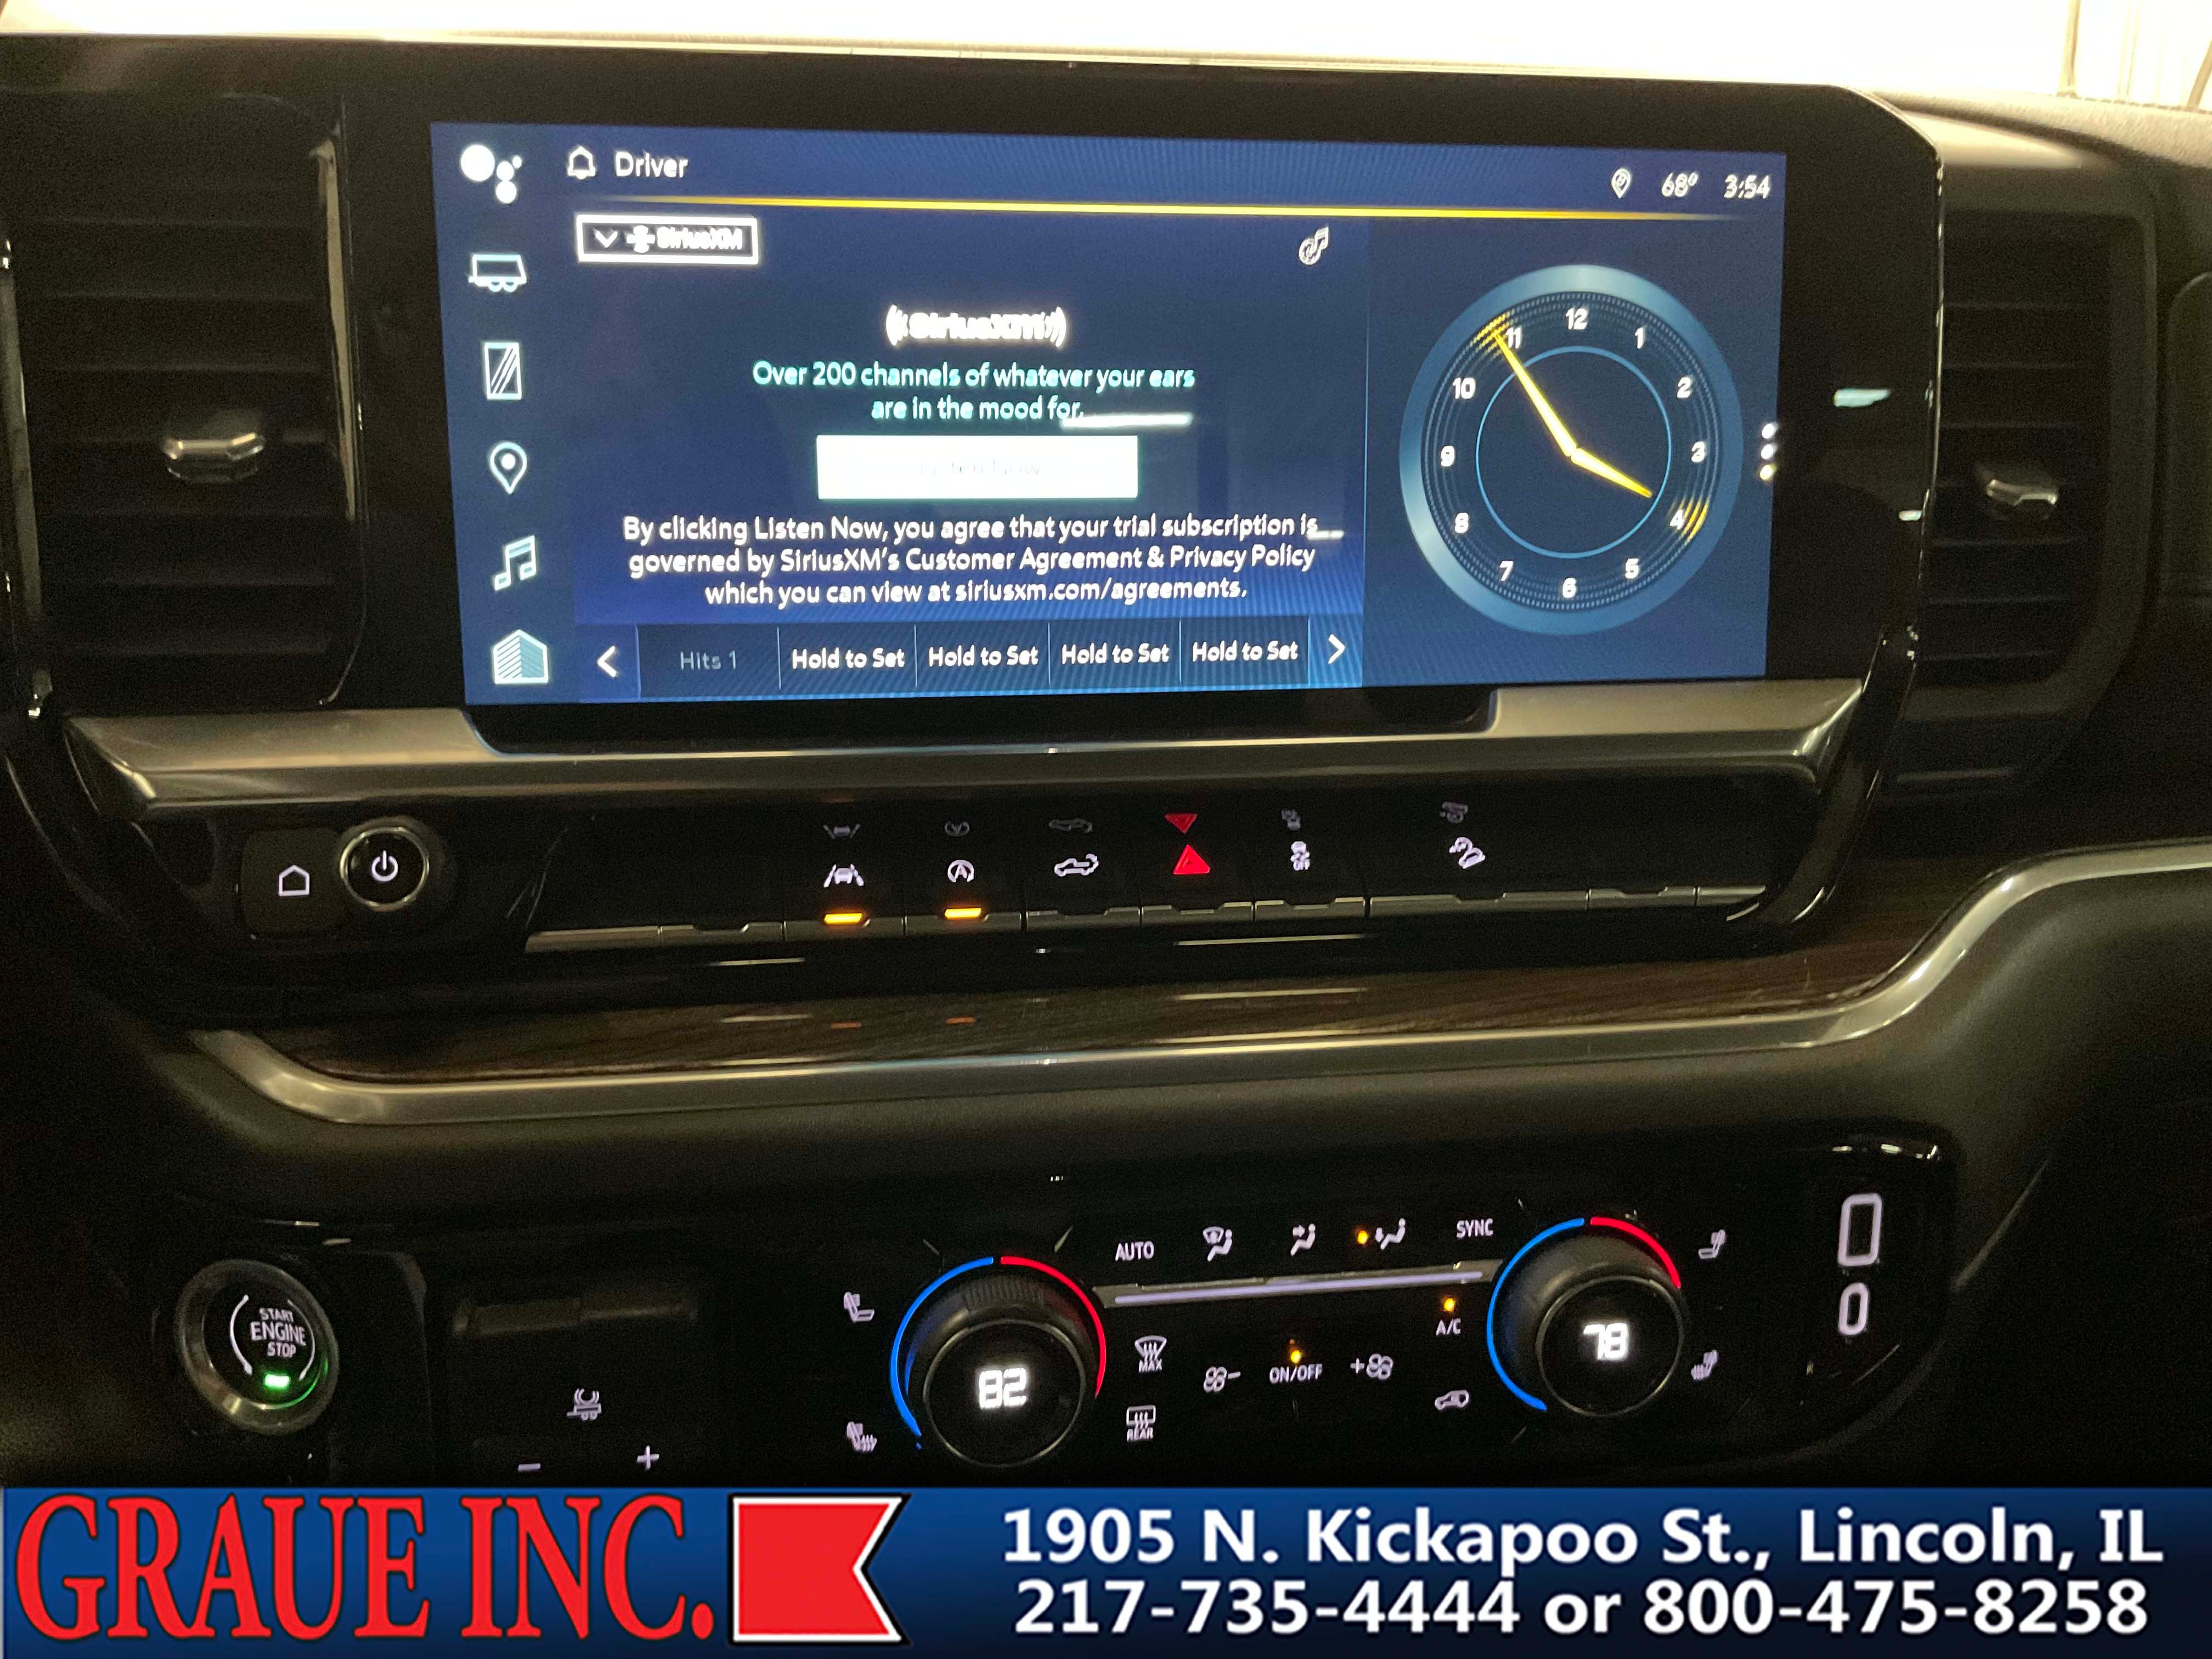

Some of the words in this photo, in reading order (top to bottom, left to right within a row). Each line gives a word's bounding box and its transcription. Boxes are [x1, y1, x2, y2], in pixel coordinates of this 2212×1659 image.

[614, 151, 690, 178] Driver
[1724, 174, 1771, 199] 3:54
[1565, 308, 1588, 331] 12
[1506, 328, 1523, 349] 11
[1634, 326, 1646, 349] 1
[753, 361, 808, 387] Over
[812, 362, 857, 387] 200
[861, 361, 961, 387] channels
[965, 362, 988, 387] of
[992, 363, 1093, 389] whatever
[1096, 368, 1144, 393] your
[1149, 368, 1196, 389] ears
[1452, 377, 1477, 399] 10
[1677, 376, 1693, 399] 2
[871, 400, 907, 420] are
[912, 397, 932, 420] in
[937, 397, 974, 420] the
[979, 397, 1043, 420] mood
[1440, 445, 1455, 467] 9
[1691, 442, 1707, 464] 3
[623, 516, 654, 545] By
[659, 515, 748, 545] clicking
[755, 516, 823, 539] Listen
[831, 516, 889, 541] Now,
[893, 520, 934, 545] you
[940, 518, 1005, 544] agree
[1009, 514, 1055, 538] that
[1058, 520, 1109, 543] your
[1113, 514, 1156, 537] trial
[1161, 513, 1295, 541] subscription
[1300, 514, 1318, 538] is
[1454, 512, 1470, 533] 8
[1670, 510, 1685, 531] 4
[629, 549, 741, 579] governed
[747, 549, 775, 577] by
[781, 548, 900, 572] SiriusXM's
[905, 546, 1014, 572] Customer
[1019, 546, 1142, 575] Agreement
[1147, 545, 1165, 568] &
[1170, 545, 1247, 572] Privacy
[1251, 543, 1316, 572] Policy
[1499, 560, 1514, 582] 7
[1624, 558, 1639, 579] 5
[706, 580, 774, 605] which
[778, 584, 820, 610] you
[826, 582, 866, 603] can
[871, 580, 923, 603] view
[928, 581, 951, 602] at
[955, 577, 1247, 605] siriusxm.com/agreements.
[1562, 578, 1577, 599] 6
[680, 651, 722, 670] Hits
[729, 650, 737, 670] 1
[792, 648, 839, 670] Hold
[845, 650, 868, 669] to
[871, 647, 905, 669] Set
[928, 646, 975, 669] Hold
[980, 647, 1003, 667] to
[1006, 644, 1039, 667] Set
[1061, 644, 1108, 665] Hold
[1112, 645, 1133, 665] to
[1137, 643, 1170, 664] Set
[1192, 640, 1238, 662] Hold
[1242, 642, 1263, 661] to
[1267, 640, 1299, 661] Set
[1456, 1218, 1494, 1239] SYNC
[1115, 1241, 1154, 1262] AUTO
[258, 1307, 293, 1321] START
[250, 1321, 306, 1346] ENGINE
[1436, 1318, 1462, 1336] A/C
[267, 1342, 296, 1357] STOP
[1582, 1322, 1629, 1362] 78
[1138, 1358, 1163, 1373] MAX
[1269, 1363, 1323, 1384] ON/OFF
[978, 1367, 1027, 1409] 82
